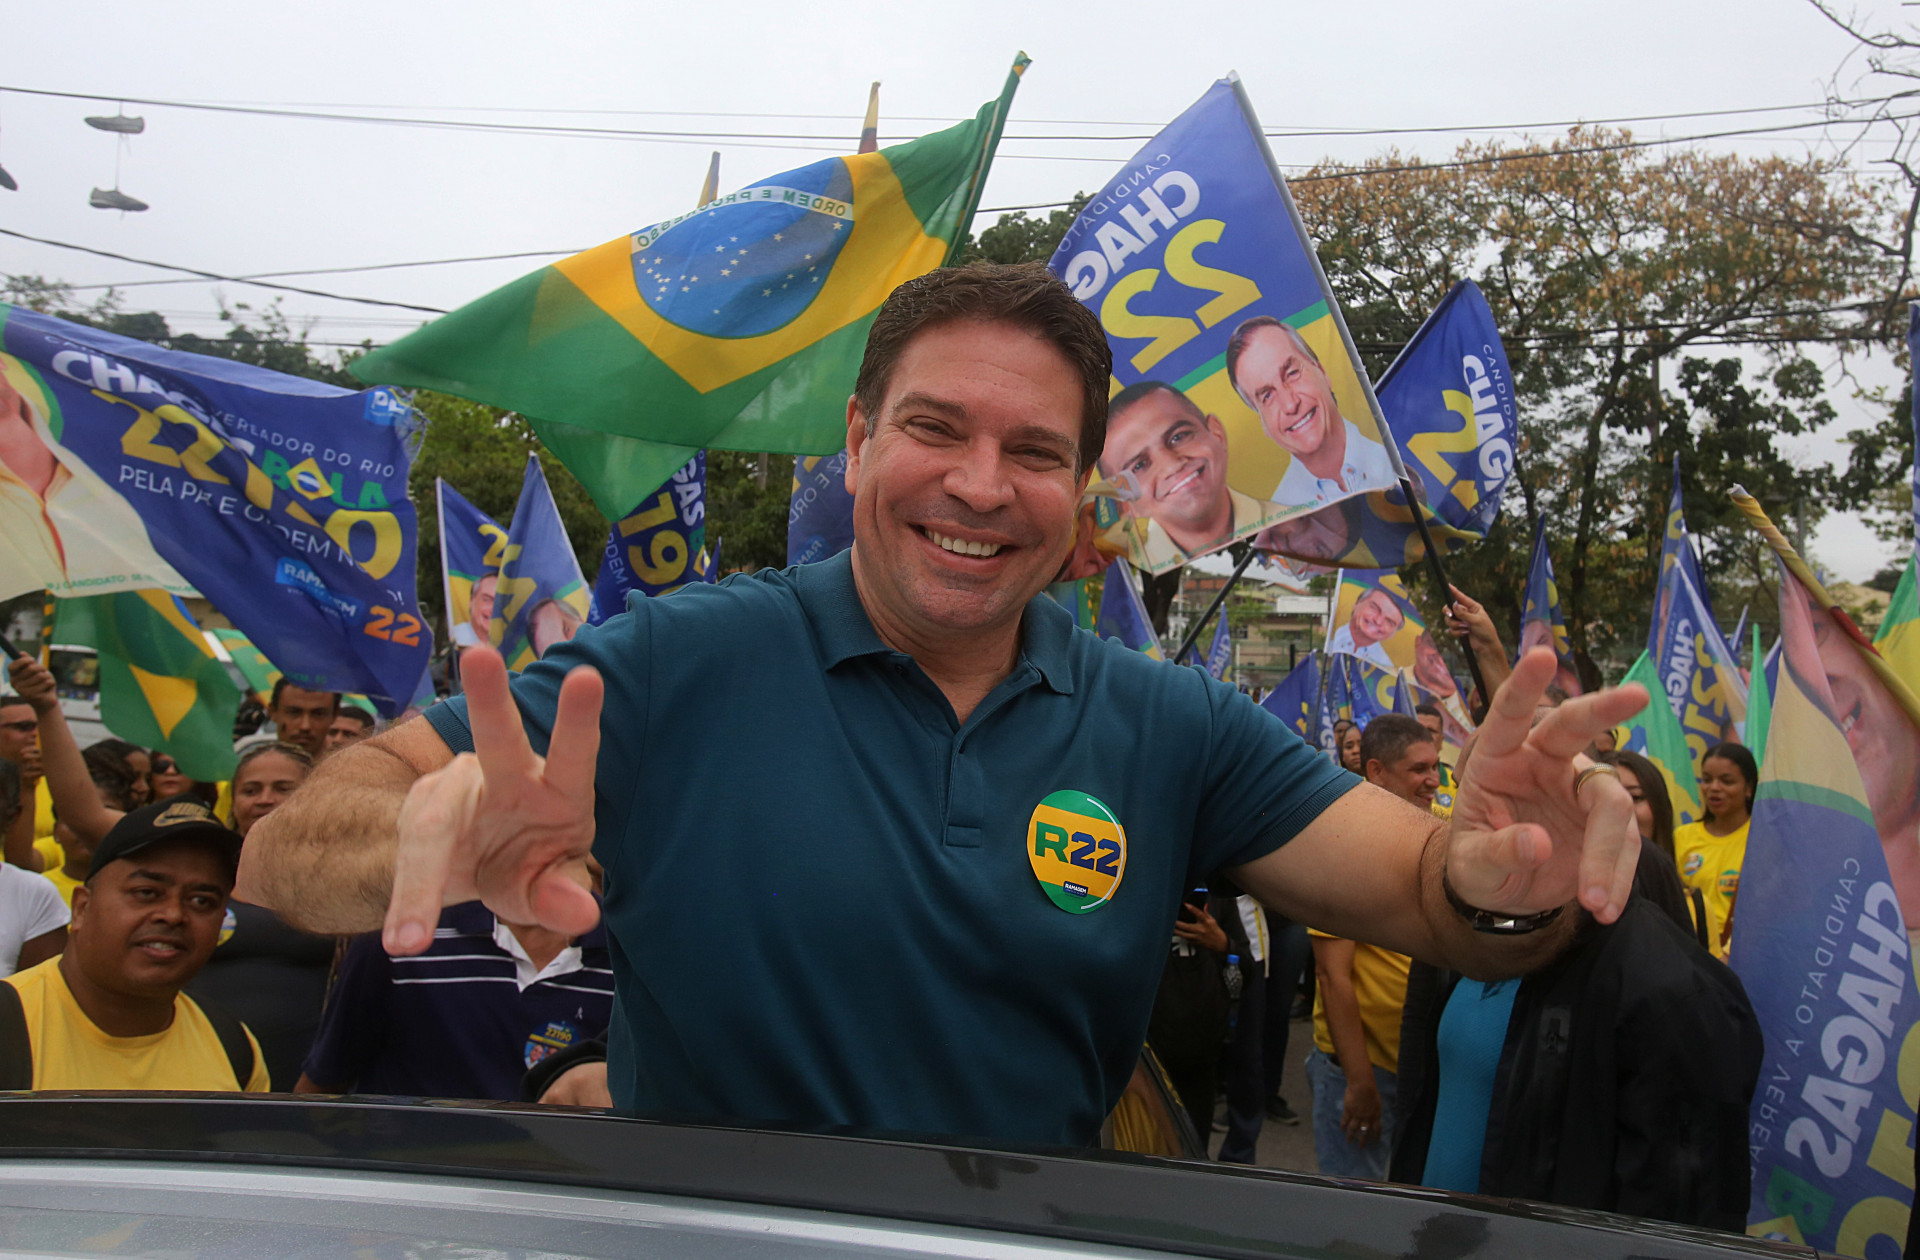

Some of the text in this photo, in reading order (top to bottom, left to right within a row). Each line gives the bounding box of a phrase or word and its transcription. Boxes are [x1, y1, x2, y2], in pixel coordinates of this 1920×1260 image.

[323, 449, 351, 466] DO
[360, 459, 395, 478] RIO
[119, 465, 174, 497] PELA
[219, 496, 238, 515] E
[363, 605, 421, 648] 22
[1035, 821, 1121, 878] R22
